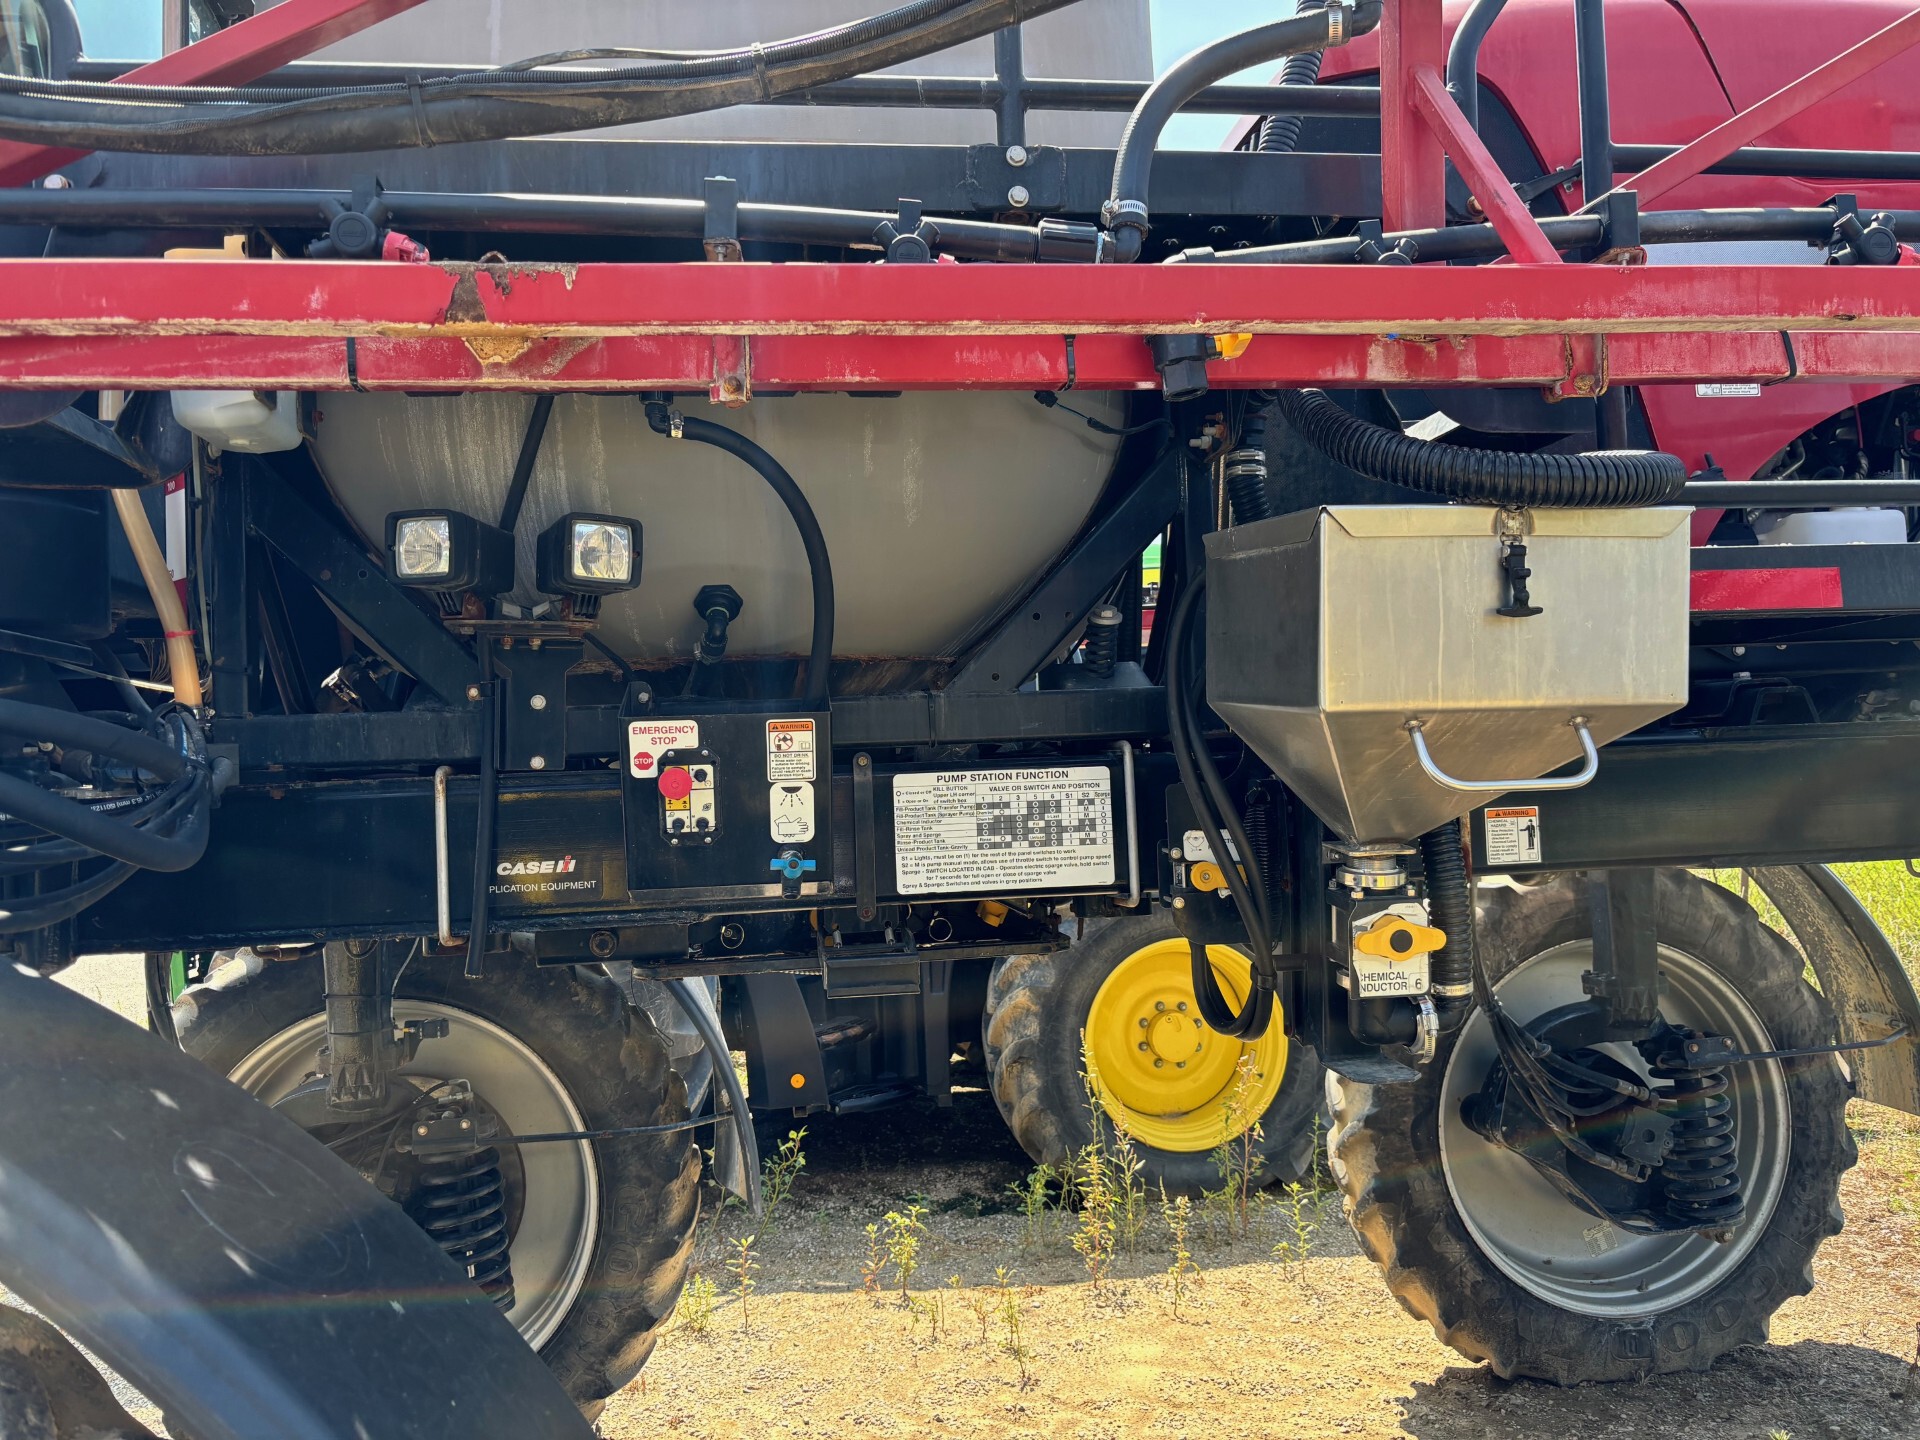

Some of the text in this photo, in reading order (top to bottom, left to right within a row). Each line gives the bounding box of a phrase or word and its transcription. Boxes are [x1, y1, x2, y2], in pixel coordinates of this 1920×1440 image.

[632, 725, 695, 735] EMERGENCY
[650, 736, 678, 746] STOP
[634, 757, 653, 765] STOP
[936, 770, 1069, 783] PUMP STATION FUNCTION
[496, 855, 576, 875] CASE IH
[489, 880, 597, 893] PLICATION EQUIPMENT
[1361, 982, 1408, 992] NDUCTOR
[1415, 978, 1422, 990] 6
